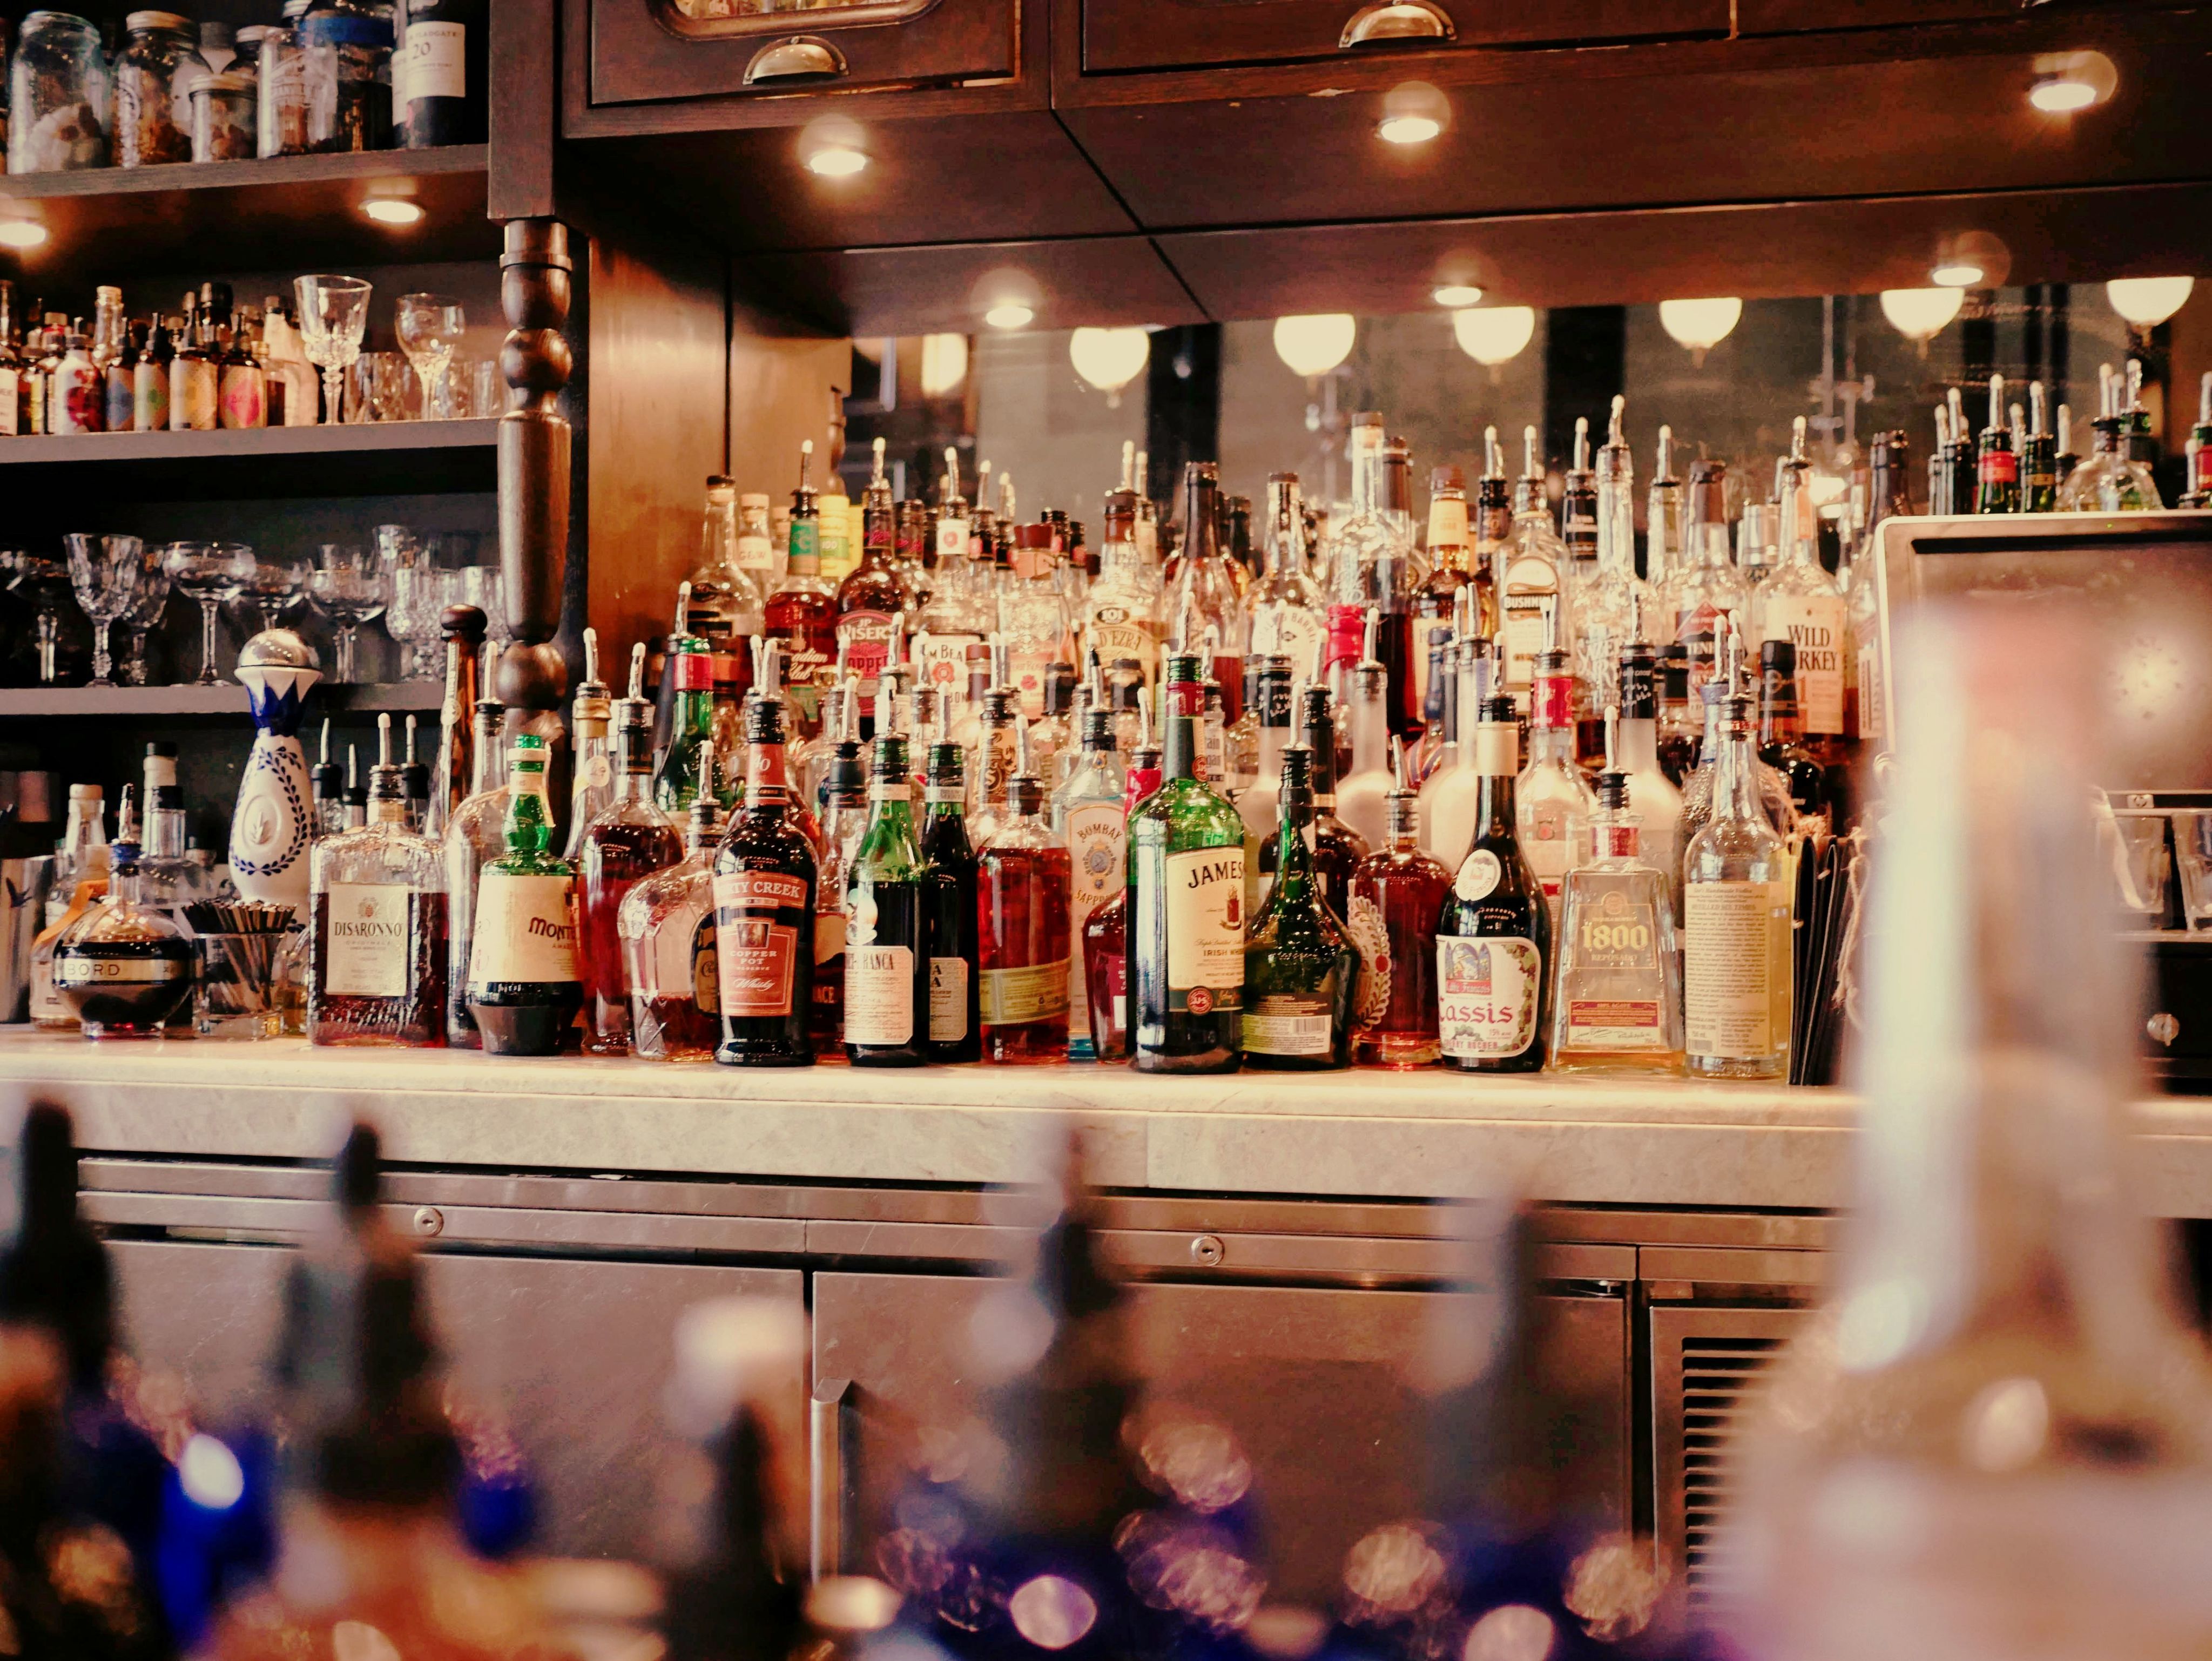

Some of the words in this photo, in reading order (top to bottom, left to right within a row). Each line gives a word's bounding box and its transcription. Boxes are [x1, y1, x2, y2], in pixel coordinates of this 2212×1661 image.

[413, 42, 430, 59] 20
[1503, 595, 1543, 609] BUSHM
[857, 619, 872, 627] JP
[1786, 624, 1830, 649] WILD
[791, 647, 828, 663] adian
[941, 644, 963, 663] BEA
[1796, 650, 1838, 672] RKEY
[847, 657, 888, 673] OPPE
[1077, 823, 1123, 843] BOMBAY
[1188, 861, 1243, 888] JAMES
[753, 881, 801, 899] CREEK
[1075, 888, 1105, 906] SAPP
[334, 922, 402, 937] DISARONNO
[1581, 924, 1648, 951] 1800
[67, 964, 120, 976] BORD
[733, 978, 775, 992] Whisky
